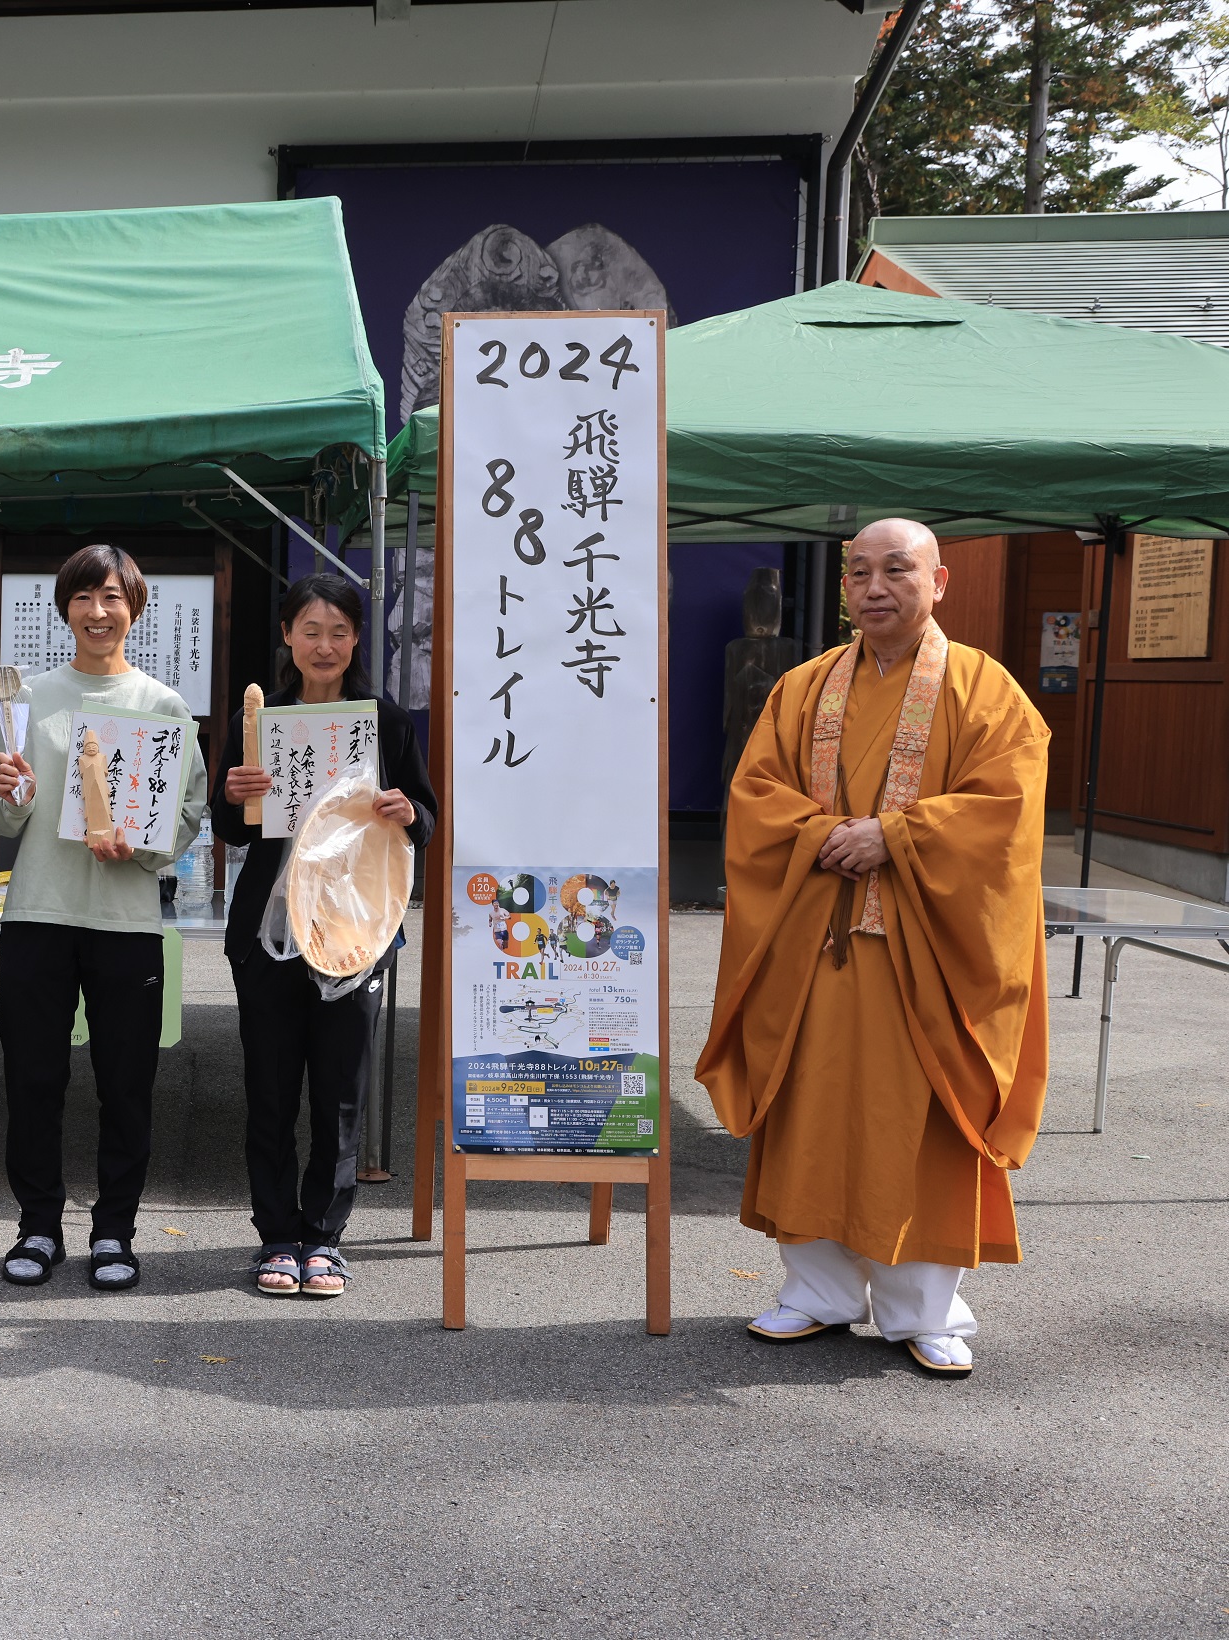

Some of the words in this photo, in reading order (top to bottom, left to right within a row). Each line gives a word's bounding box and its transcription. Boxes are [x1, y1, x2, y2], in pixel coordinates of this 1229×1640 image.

[477, 334, 640, 390] 2024
[561, 409, 627, 698] 飛騨千光寺
[172, 603, 182, 687] 丹生川村指定重要文化財
[364, 719, 376, 746] ひだ
[301, 745, 316, 802] 令和六年十
[548, 876, 558, 923] 飛騨千光寺
[493, 962, 558, 980] TRAIL
[602, 985, 625, 993] 13km
[468, 1062, 577, 1071] 2024飛騨千光寺88トレイル
